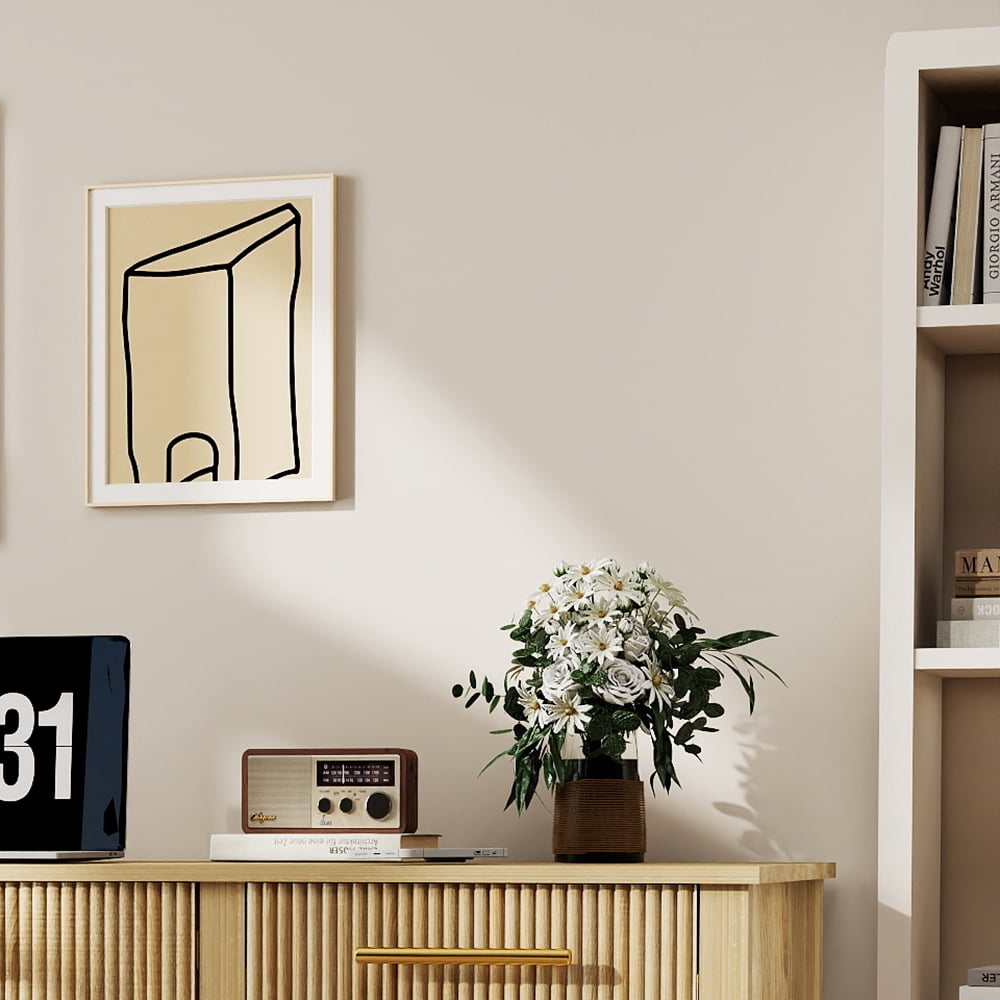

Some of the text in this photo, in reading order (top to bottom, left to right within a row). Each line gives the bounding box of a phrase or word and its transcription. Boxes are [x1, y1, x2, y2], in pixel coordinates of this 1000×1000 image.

[989, 154, 1000, 280] GIORGIO ARMANI
[923, 251, 936, 290] Andy
[929, 246, 946, 297] Warhol
[961, 556, 1000, 574] MA
[273, 838, 288, 846] Zeit
[338, 838, 378, 846] Architektur
